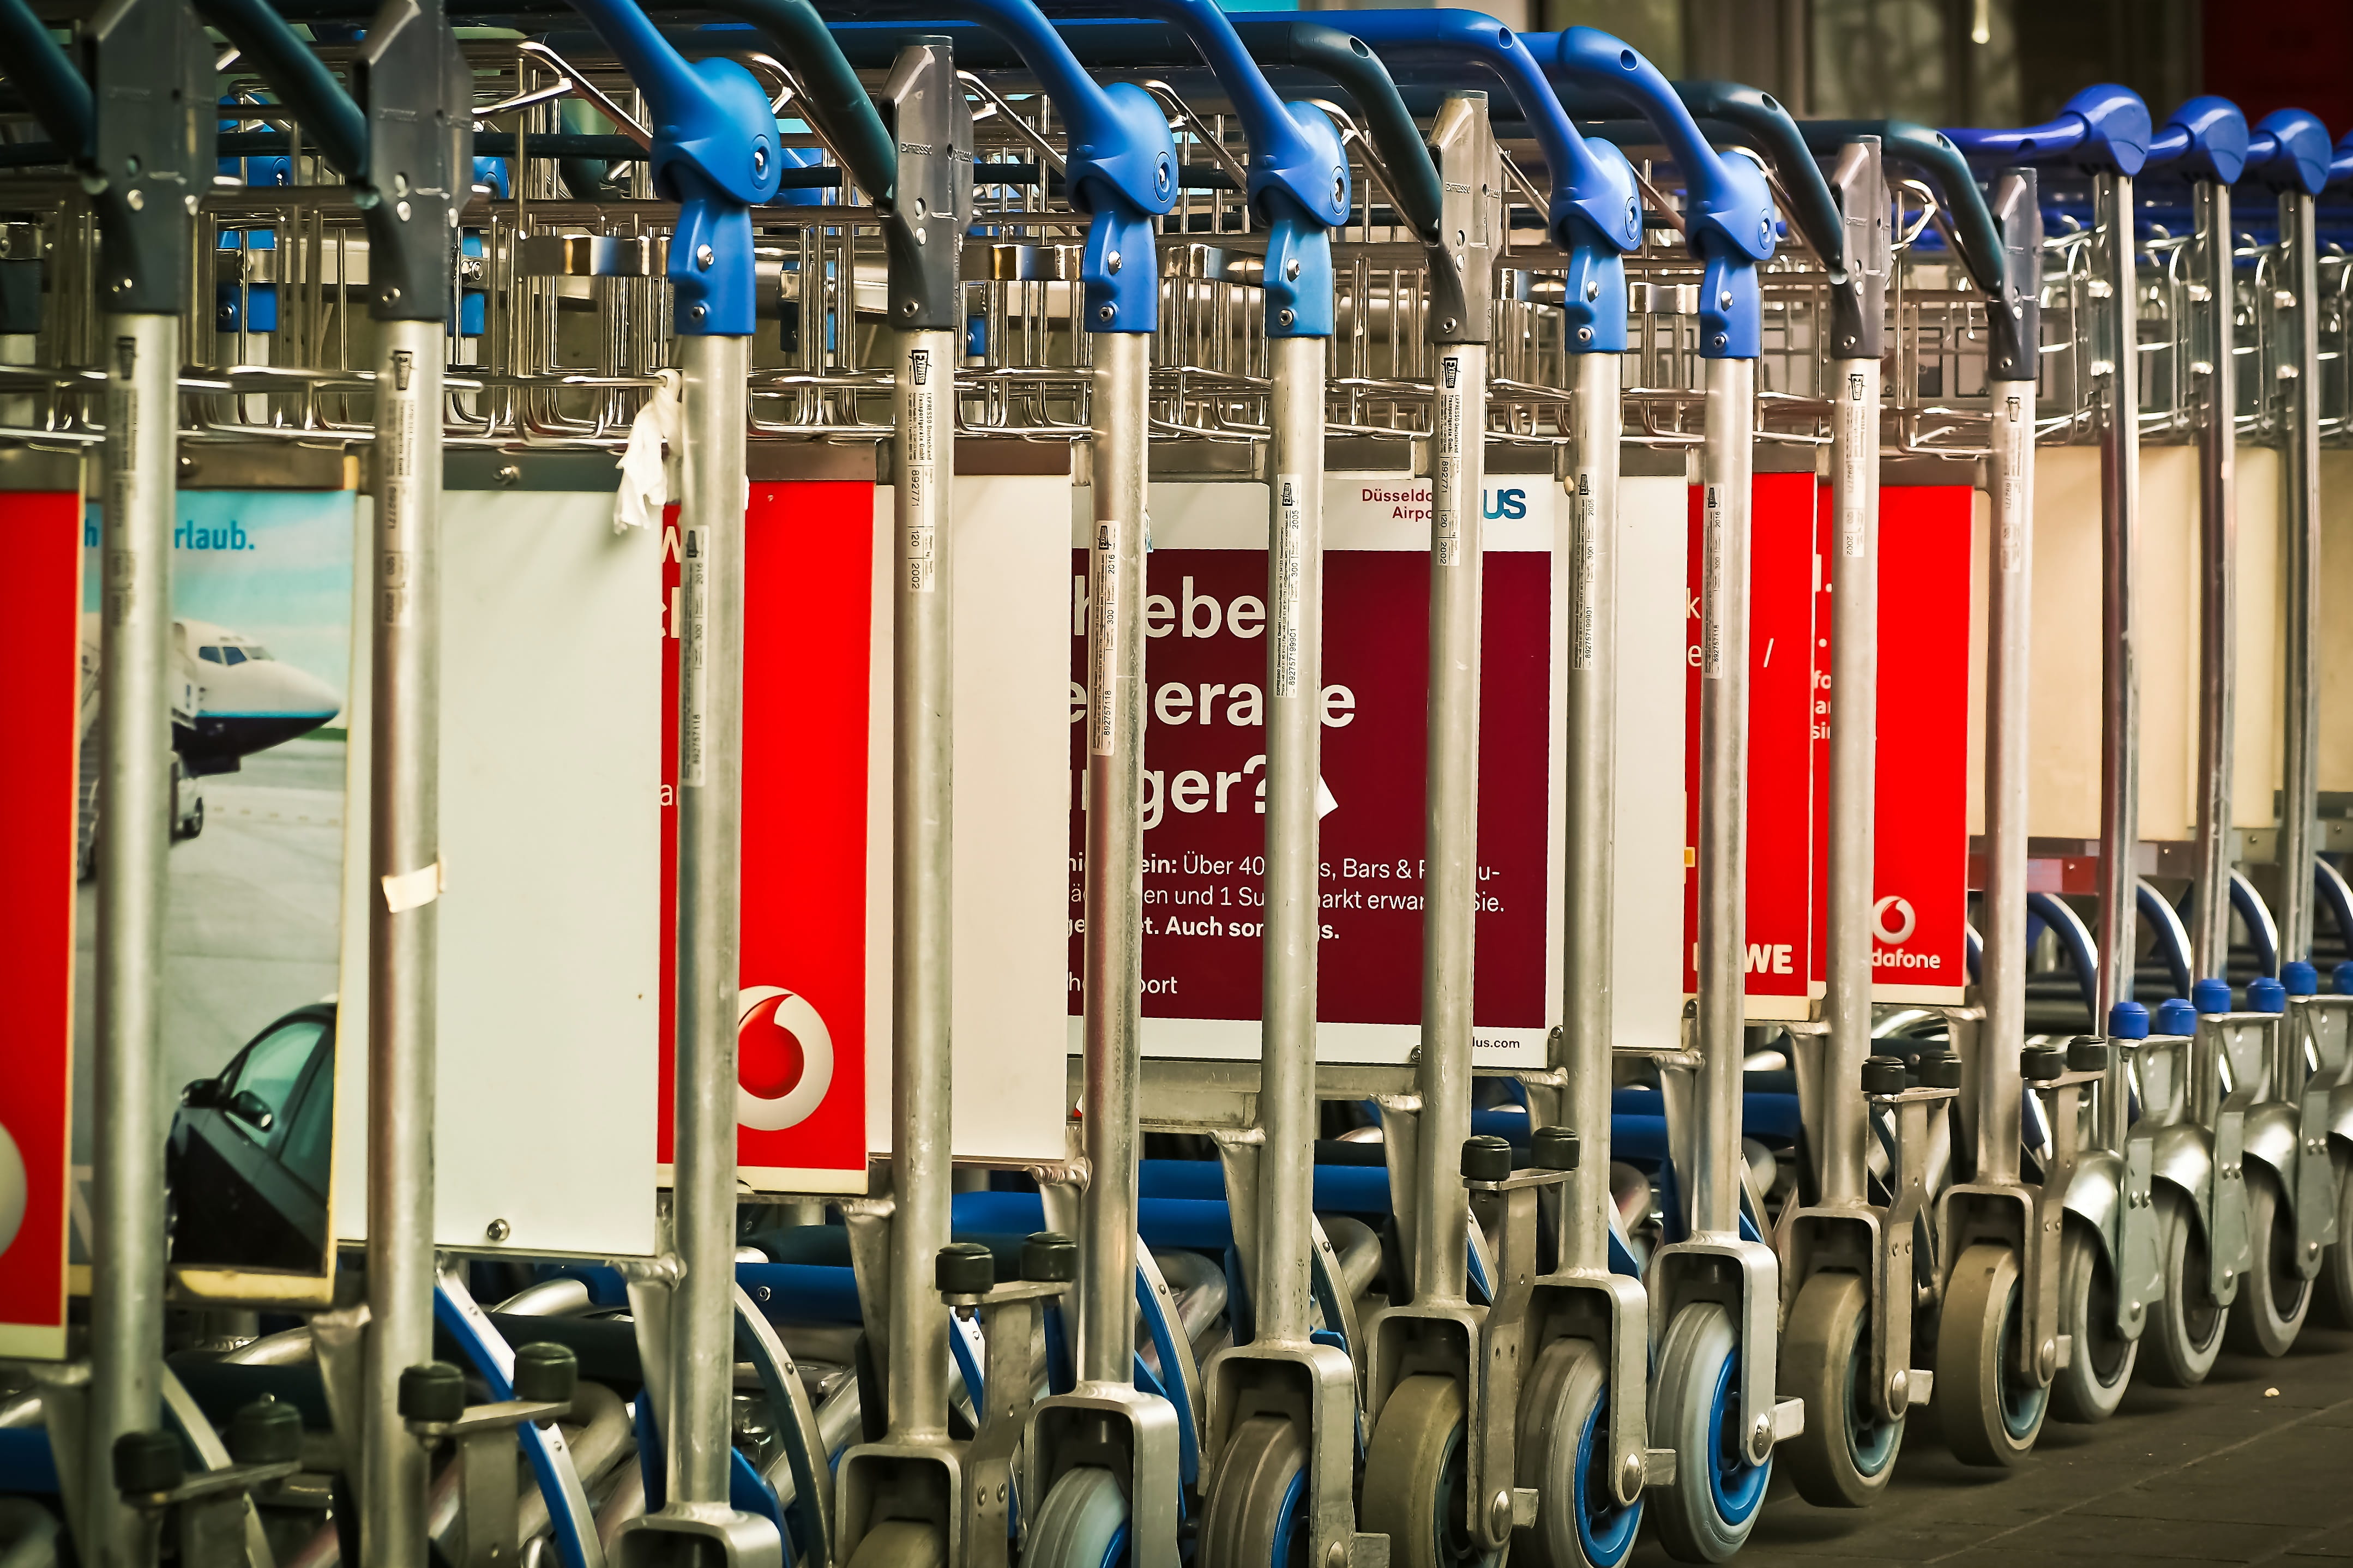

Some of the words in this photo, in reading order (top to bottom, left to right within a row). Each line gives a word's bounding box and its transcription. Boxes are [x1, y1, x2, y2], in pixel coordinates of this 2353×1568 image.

[915, 353, 928, 383] EXPRESSO
[1447, 361, 1456, 387] EXPRESSO
[911, 469, 920, 507] 892771
[1362, 489, 1433, 502] Düsseldo
[1392, 506, 1433, 522] Airpo
[1483, 489, 1526, 520] US
[174, 520, 255, 550] rlaub.
[911, 529, 920, 547] 120
[911, 563, 920, 589] 2002
[1289, 628, 1297, 686] 892757199901
[1142, 854, 1177, 873] ein:
[1183, 851, 1233, 875] Über
[1239, 856, 1265, 876] 40
[1343, 858, 1390, 879] Bars
[1396, 859, 1412, 879] &
[1175, 885, 1213, 905] und
[1220, 887, 1232, 906] 1
[1165, 916, 1222, 936] Auch
[1872, 948, 1941, 969] dafone
[1472, 1036, 1520, 1048] lus.com
